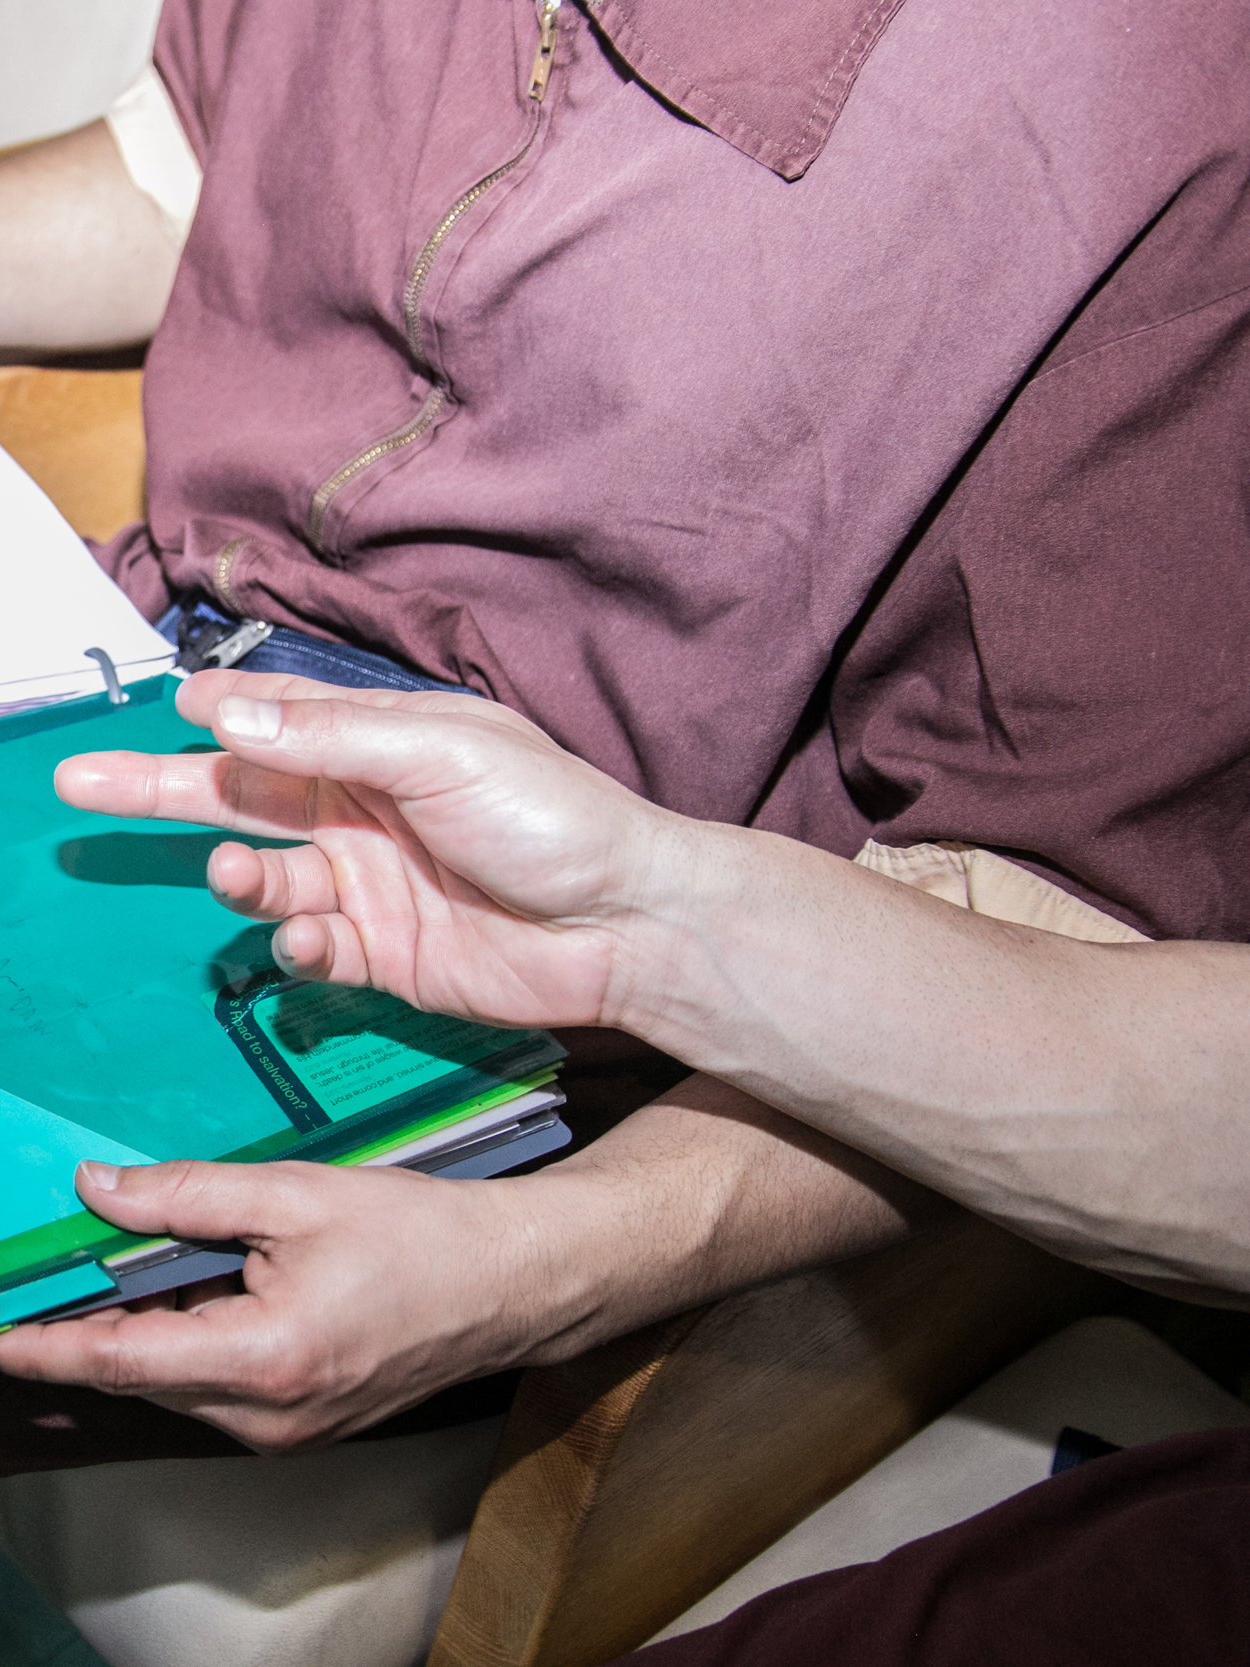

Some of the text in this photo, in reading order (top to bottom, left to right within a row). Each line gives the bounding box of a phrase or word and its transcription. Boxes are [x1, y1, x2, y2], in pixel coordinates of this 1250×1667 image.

[311, 1029, 365, 1059] commendeth
[296, 1052, 312, 1064] His
[371, 1046, 384, 1057] life
[374, 1047, 402, 1065] wages
[230, 1011, 256, 1041] Road
[250, 1041, 263, 1055] to
[259, 1056, 308, 1110] salvation?
[336, 1050, 370, 1071] through
[365, 1060, 375, 1069] of
[309, 1065, 336, 1082] Jesus
[343, 1069, 352, 1078] is
[351, 1064, 365, 1075] sin
[393, 1062, 425, 1080] sinned,
[377, 1075, 395, 1087] and
[352, 1082, 378, 1097] come
[330, 1092, 354, 1106] short
